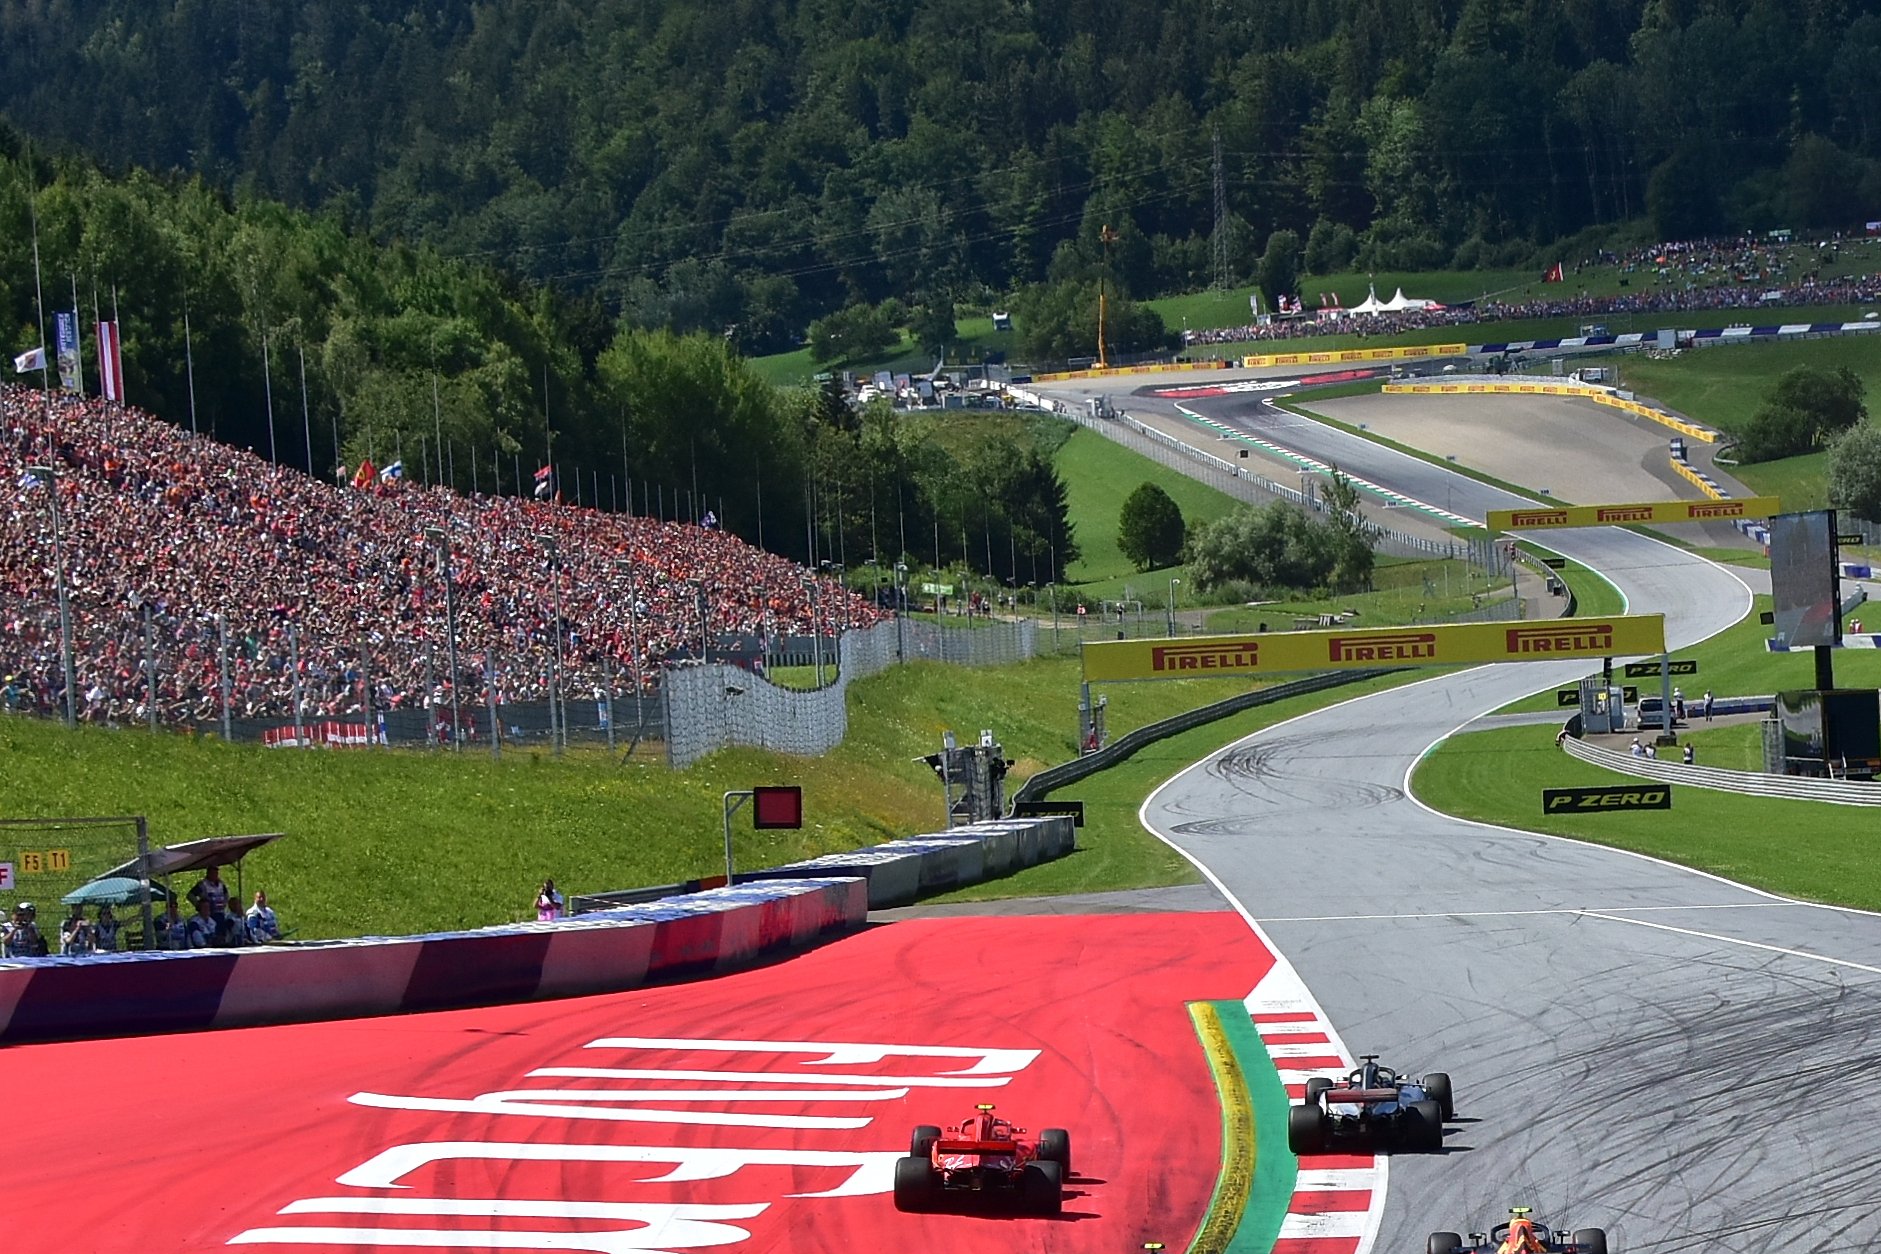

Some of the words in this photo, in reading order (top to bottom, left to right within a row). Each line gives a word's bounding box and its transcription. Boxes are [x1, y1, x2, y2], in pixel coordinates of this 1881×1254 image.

[1597, 507, 1652, 522] PIRELLI
[1688, 503, 1743, 518] PIRELLI
[1512, 511, 1567, 526] PIRELLI
[1506, 624, 1613, 653] PIRELLI
[1329, 634, 1435, 662] PIRELLI
[1152, 643, 1258, 671] PIRELLI
[1549, 795, 1572, 808] P
[1577, 791, 1665, 807] ZERO
[25, 855, 39, 870] F5
[52, 853, 66, 867] T1
